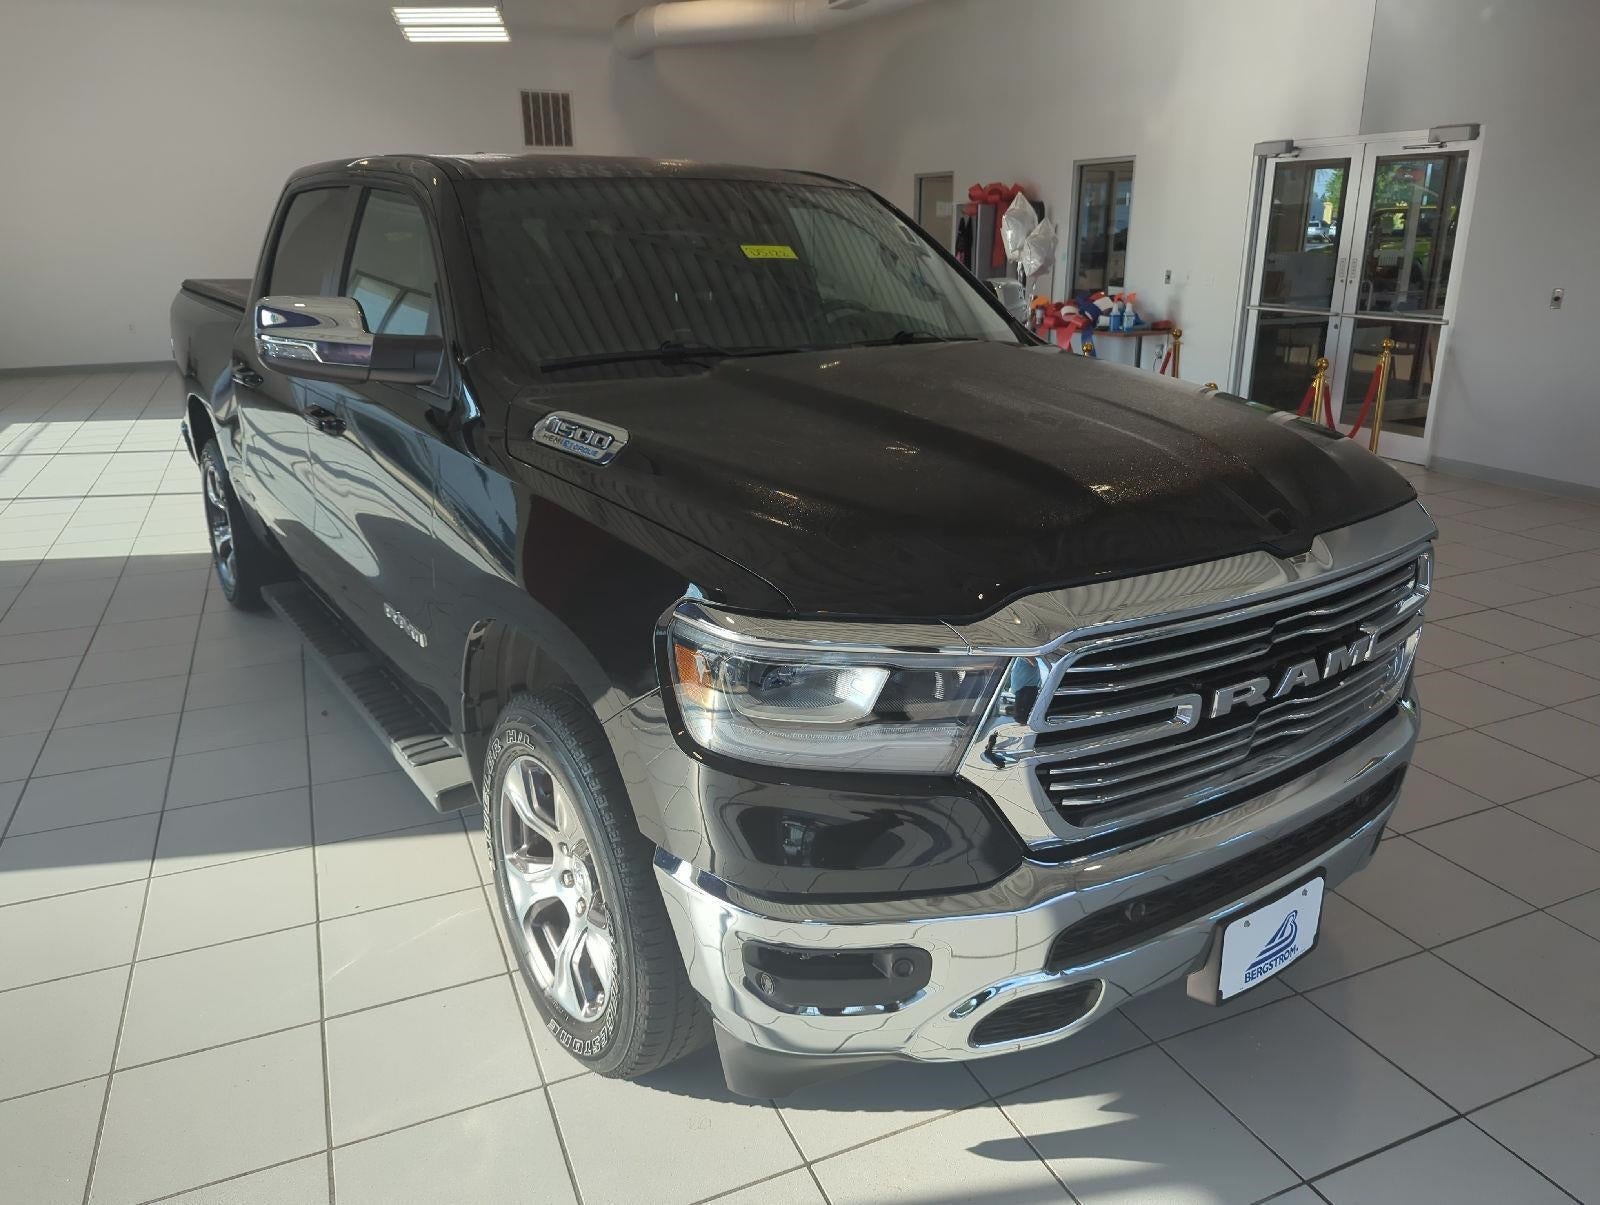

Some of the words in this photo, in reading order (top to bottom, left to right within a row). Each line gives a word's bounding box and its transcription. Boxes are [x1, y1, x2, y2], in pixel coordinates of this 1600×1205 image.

[545, 416, 613, 450] 1500
[1210, 632, 1375, 719] RAM
[1244, 944, 1297, 984] BERGSTROM
